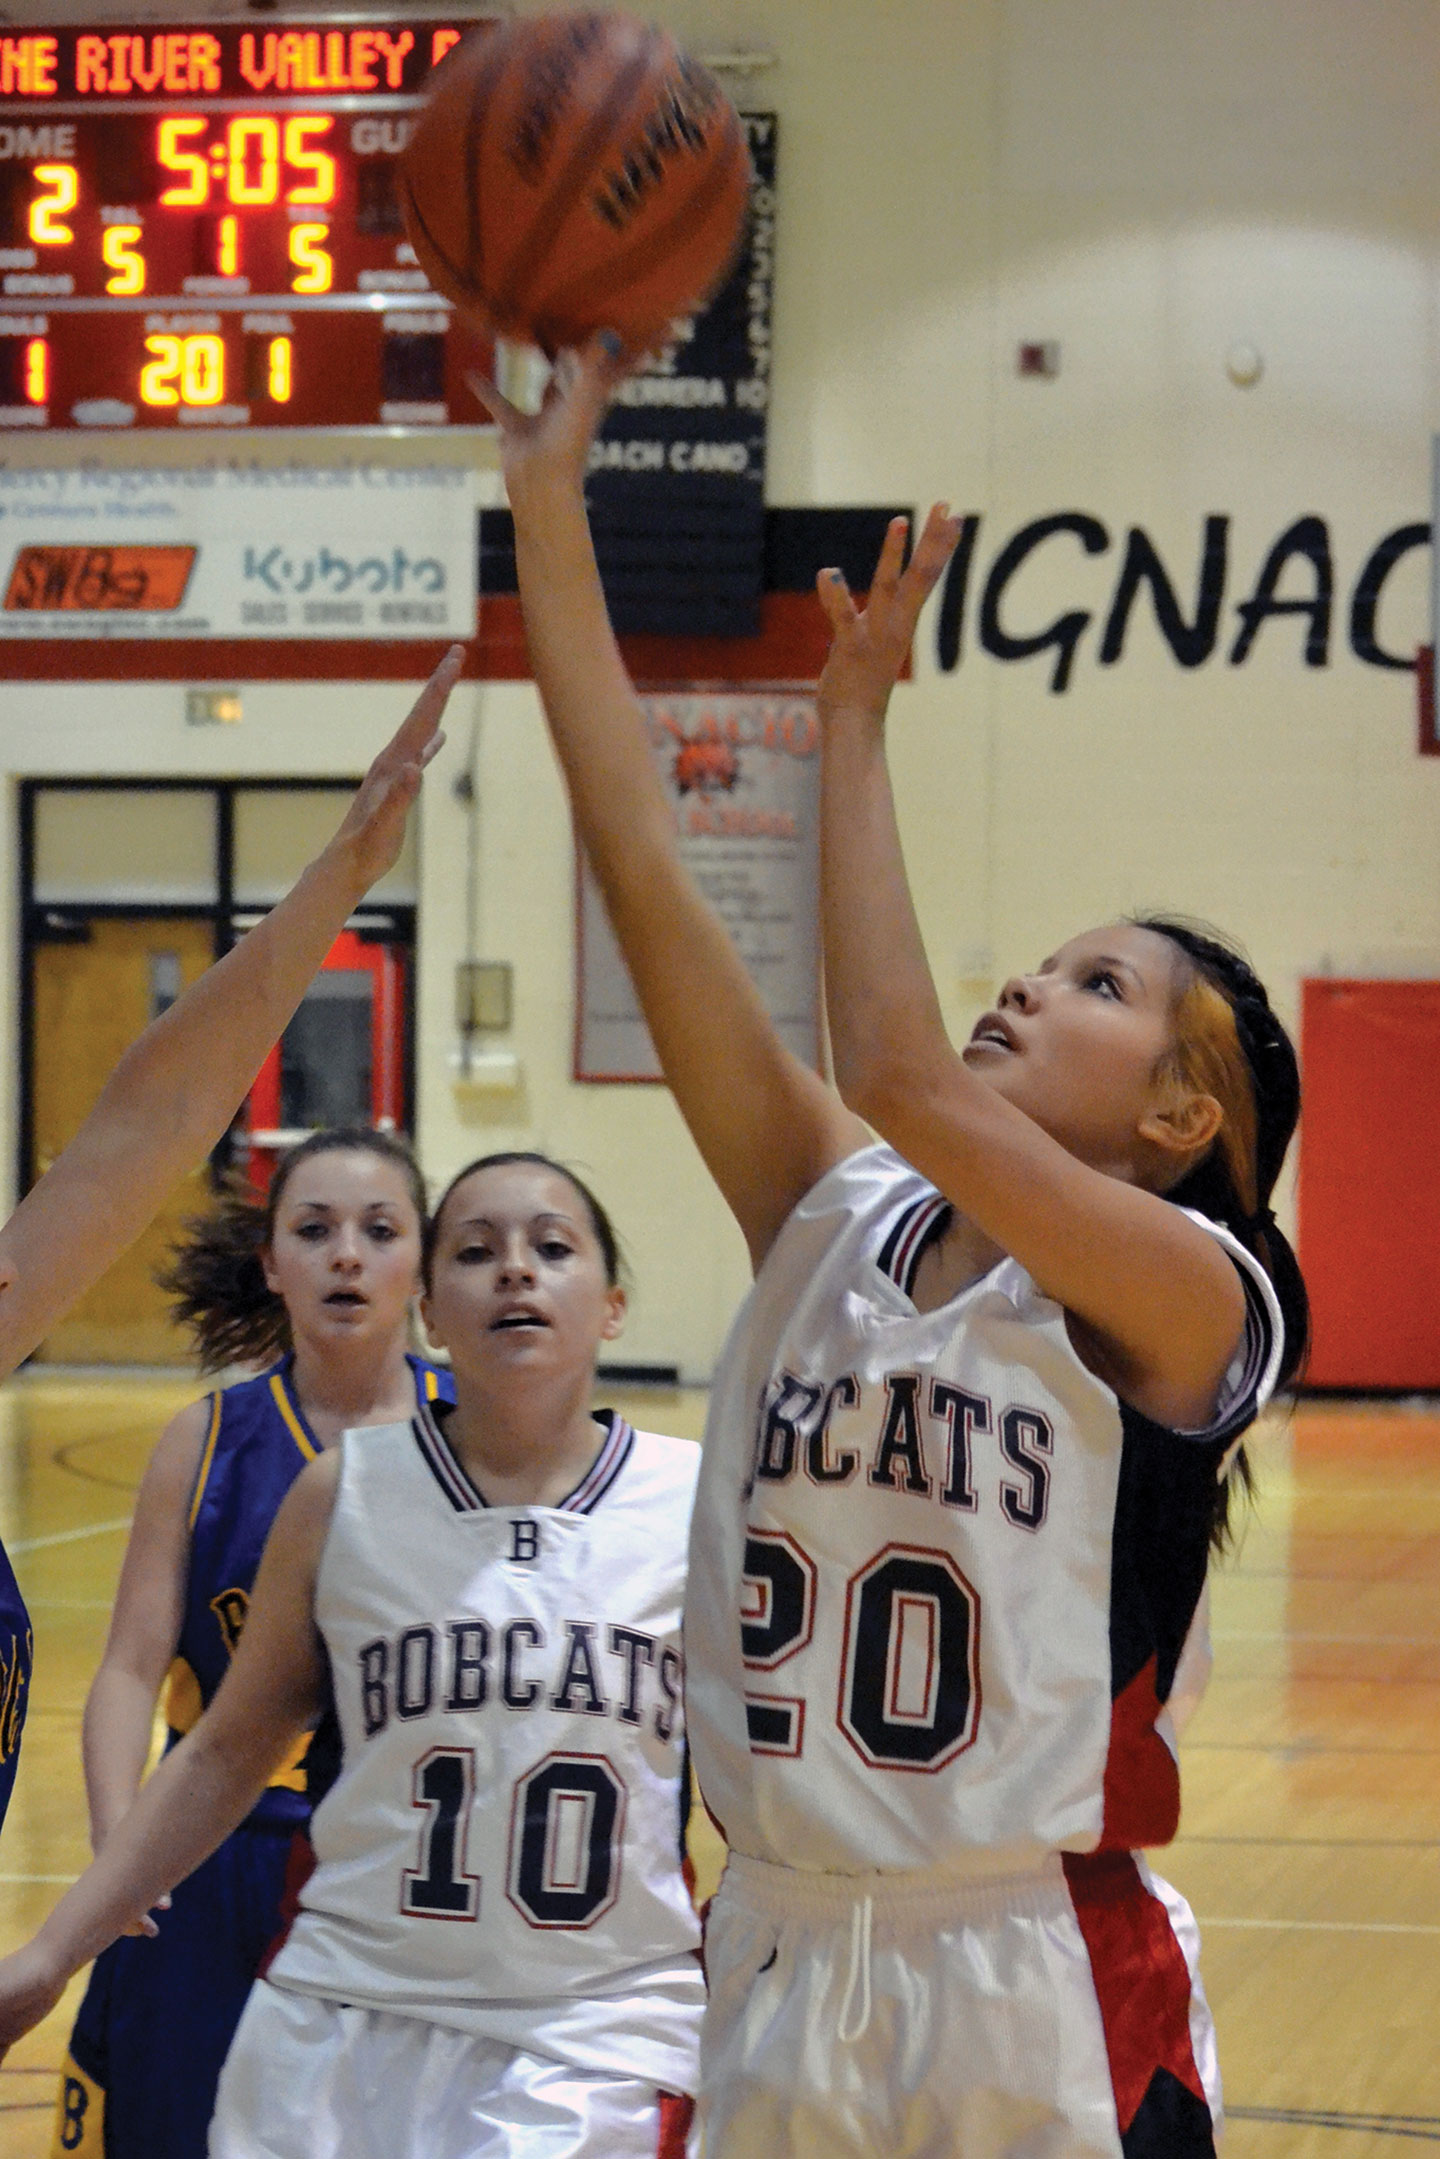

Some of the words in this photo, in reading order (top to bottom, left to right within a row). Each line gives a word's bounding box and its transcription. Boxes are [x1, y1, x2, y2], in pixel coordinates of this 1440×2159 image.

[76, 35, 221, 92] RIVER
[240, 30, 415, 90] VALLEY
[157, 117, 336, 206] 5:05
[29, 164, 78, 244] 2
[102, 225, 145, 294] 5
[218, 214, 238, 278] 1
[289, 222, 333, 293] 5
[26, 337, 48, 404] 1
[140, 335, 224, 405] 20
[268, 336, 292, 404] 1
[243, 546, 448, 593] Kubota
[508, 1520, 539, 1562] B
[358, 1616, 686, 1746] BOBCATS
[740, 1524, 982, 1776] 20
[400, 1745, 628, 1931] 10
